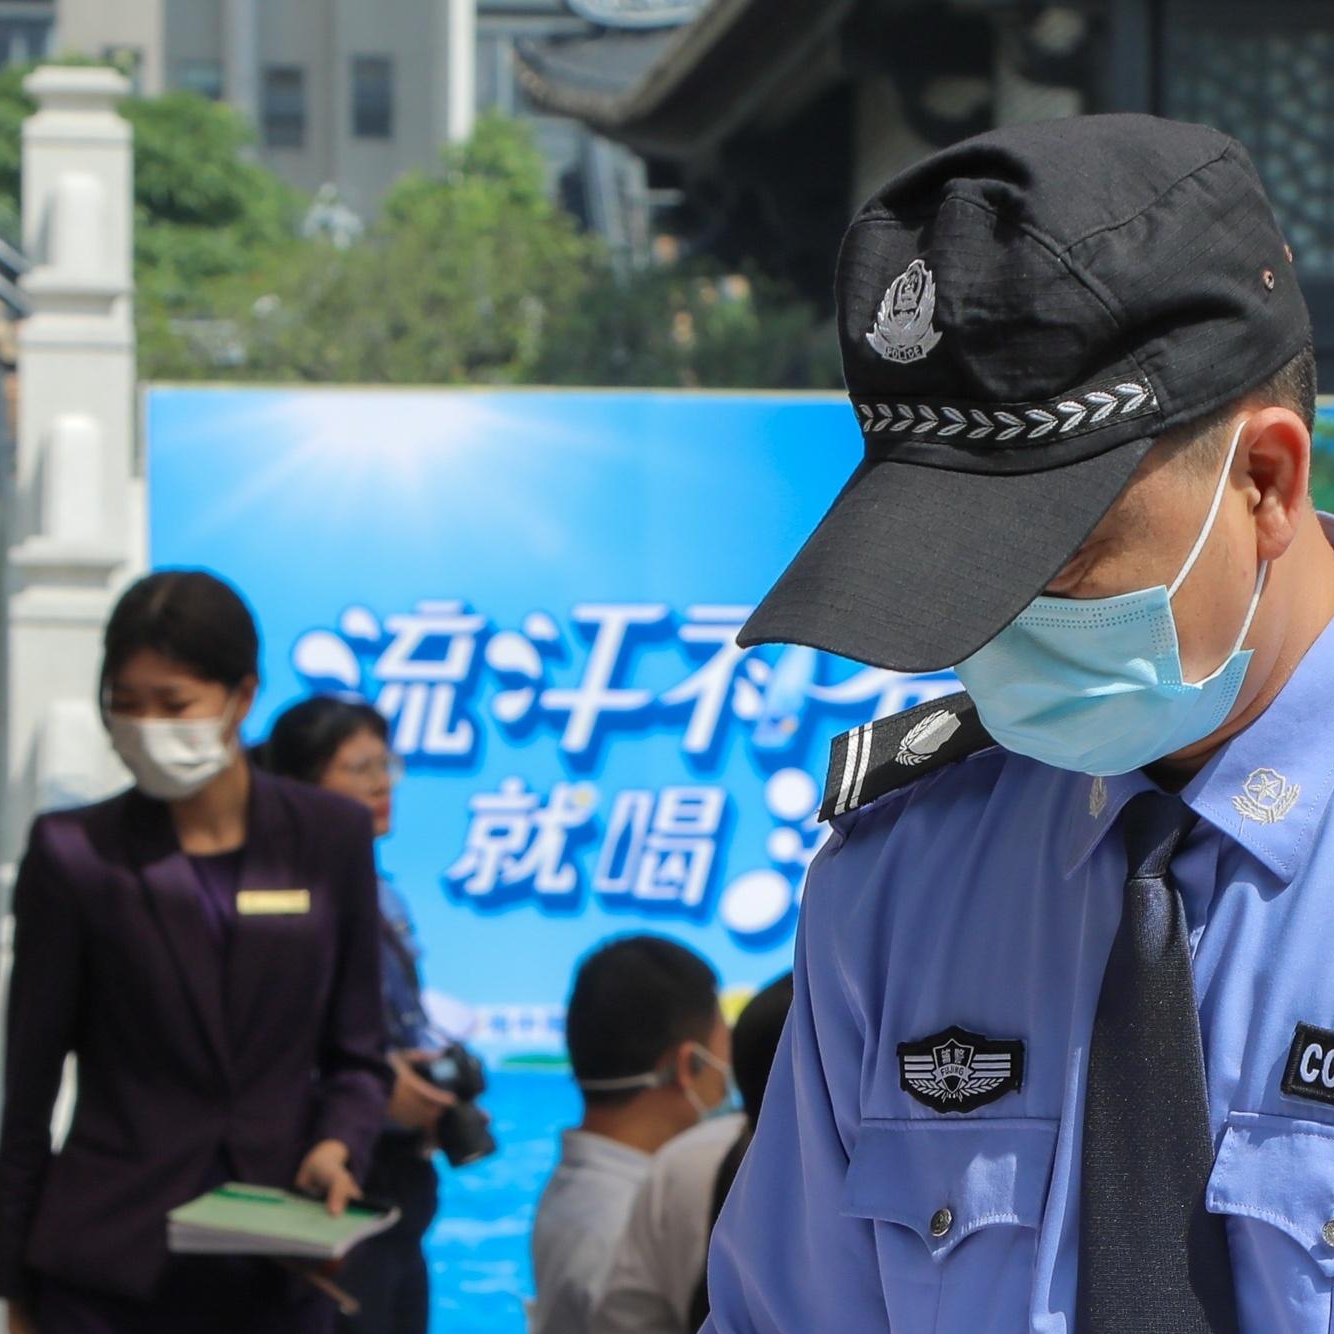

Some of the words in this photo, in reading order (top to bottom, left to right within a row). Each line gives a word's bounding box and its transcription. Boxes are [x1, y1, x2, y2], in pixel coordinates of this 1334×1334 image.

[886, 345, 923, 360] POLICE
[294, 600, 967, 757] 流汗
[940, 1066, 965, 1077] FUJING
